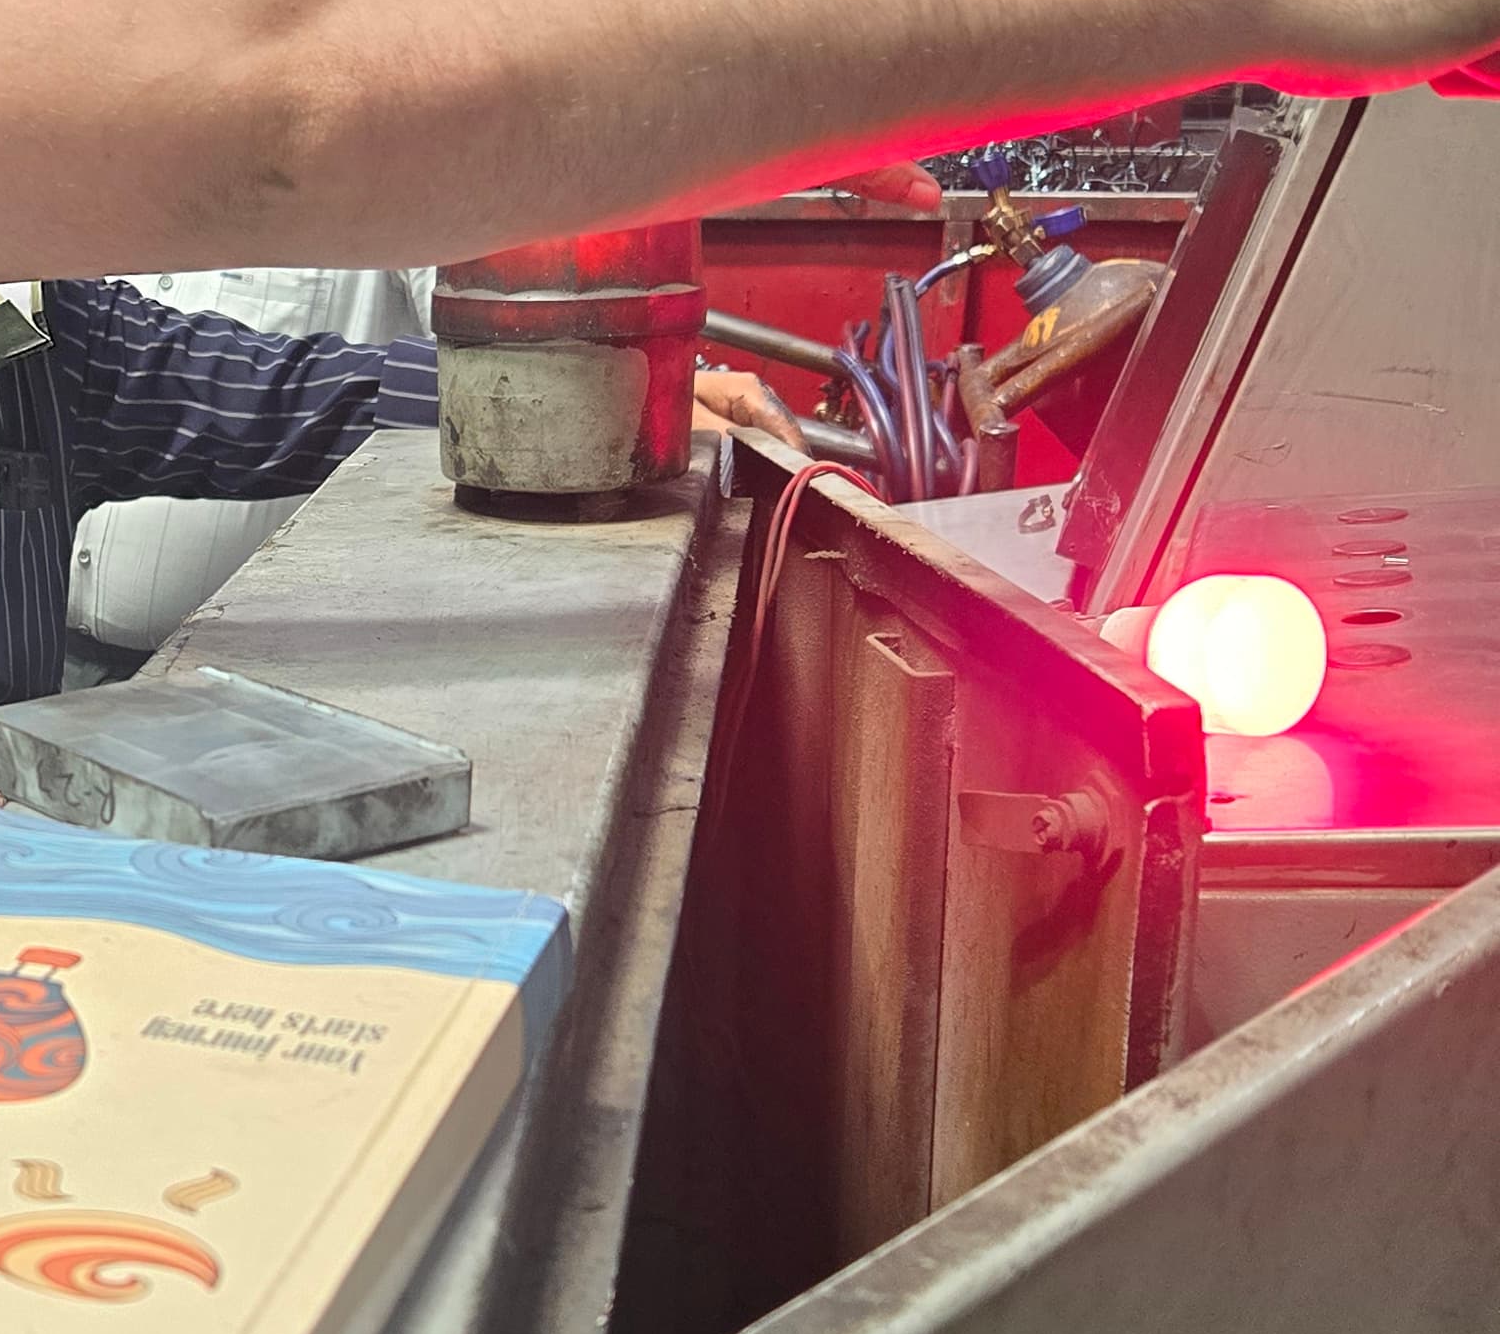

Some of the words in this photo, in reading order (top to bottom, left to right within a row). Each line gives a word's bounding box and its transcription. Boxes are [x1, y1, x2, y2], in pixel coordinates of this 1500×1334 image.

[192, 998, 276, 1030] here
[281, 1011, 389, 1045] starts
[140, 1014, 283, 1061] journey
[281, 1039, 365, 1075] Your
